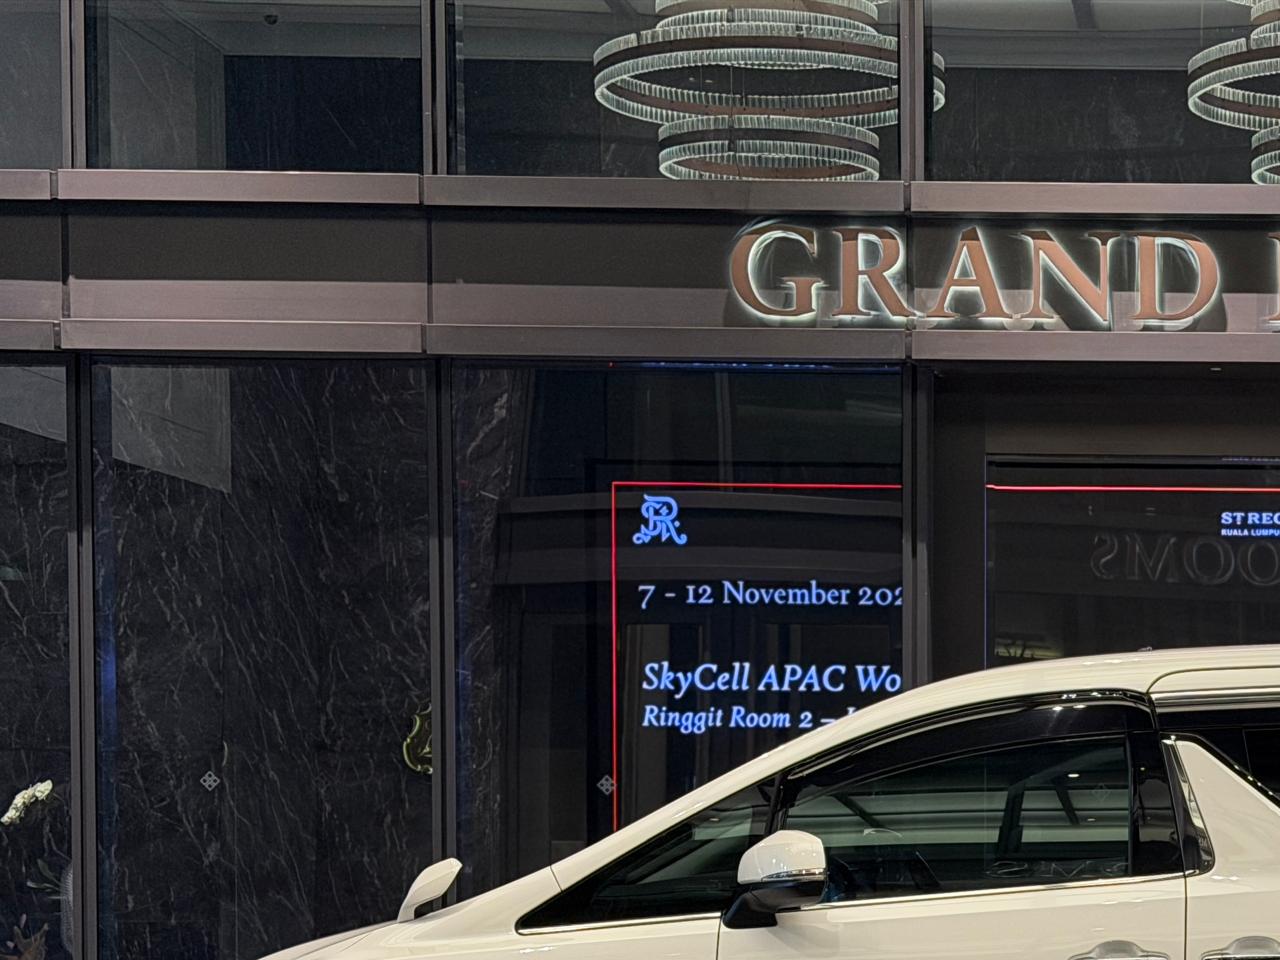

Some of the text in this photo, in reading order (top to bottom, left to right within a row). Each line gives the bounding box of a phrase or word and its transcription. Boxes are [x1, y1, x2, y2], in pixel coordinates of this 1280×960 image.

[729, 226, 1220, 320] GRAND
[1221, 528, 1249, 537] KUALA
[638, 585, 655, 609] 7
[722, 580, 851, 606] November
[642, 661, 901, 699] SkyCell APAC Wo
[642, 704, 723, 734] Ringgit
[729, 706, 791, 728] Room
[799, 711, 813, 728] 2
